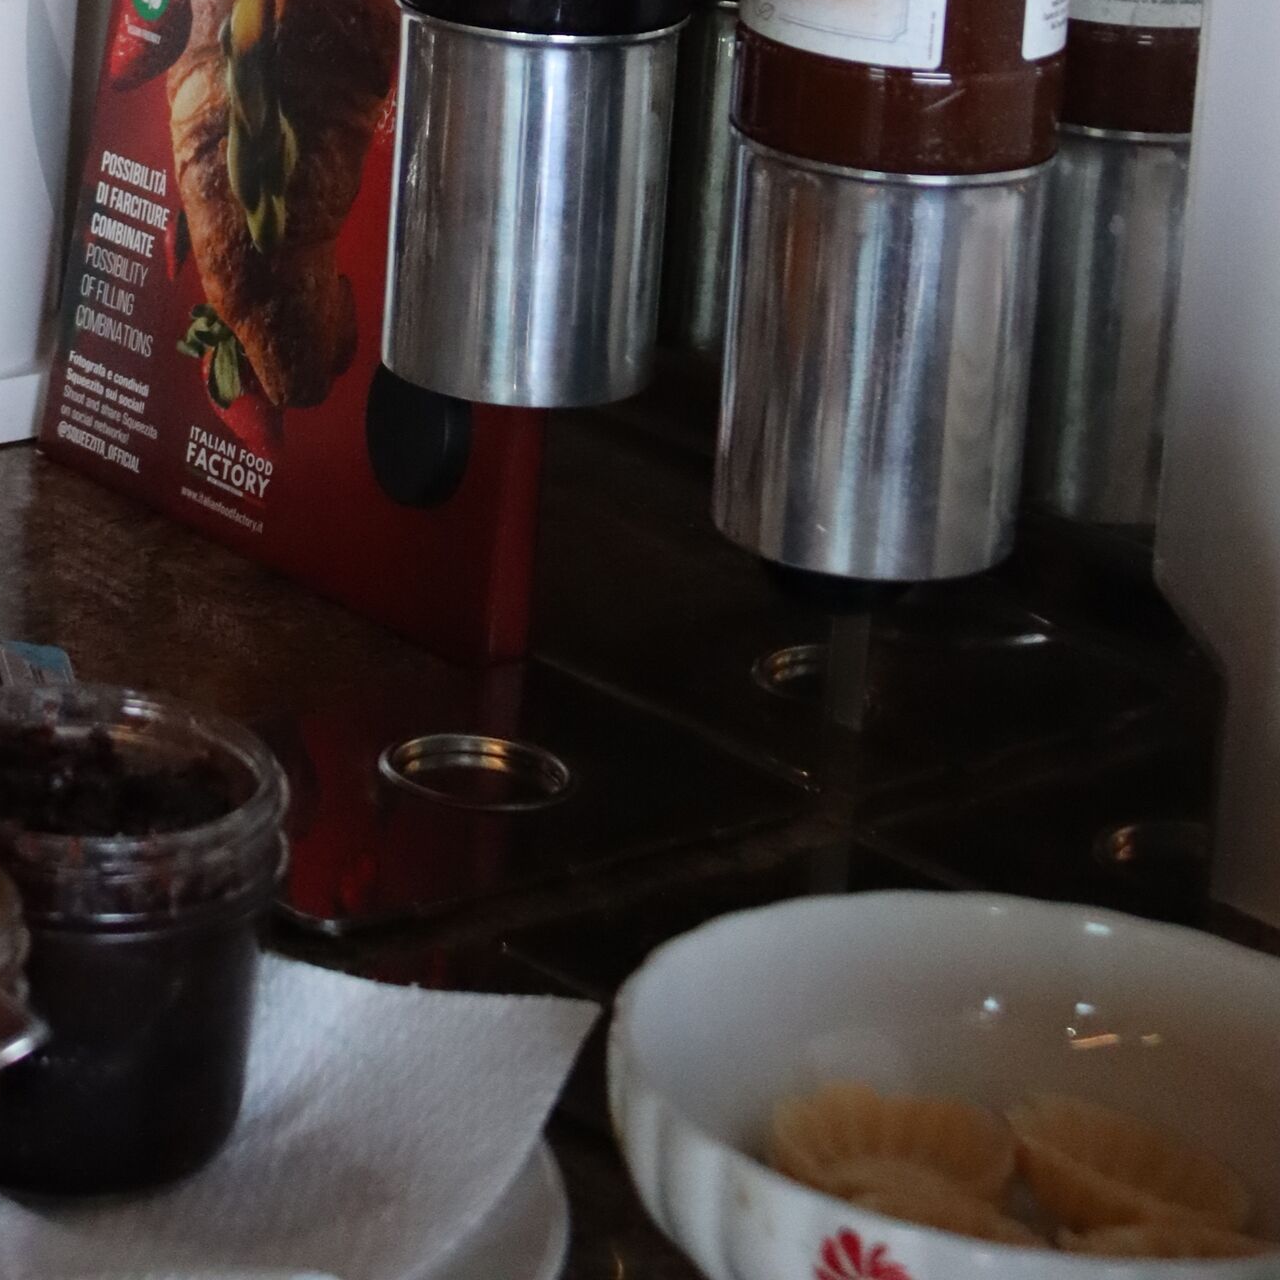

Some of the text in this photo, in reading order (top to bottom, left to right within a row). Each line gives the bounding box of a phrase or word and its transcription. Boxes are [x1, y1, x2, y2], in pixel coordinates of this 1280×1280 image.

[101, 151, 167, 197] POSSIBILITÀ
[95, 181, 170, 230] DI FARCITURE
[91, 212, 155, 258] COMBINATE
[85, 242, 148, 287] POSSIBILITY
[81, 274, 135, 316] OF FILLING
[75, 304, 153, 357] COMBINATIONS
[186, 442, 271, 499] FACTORY
[189, 425, 274, 476] ITALIAN FOOD
